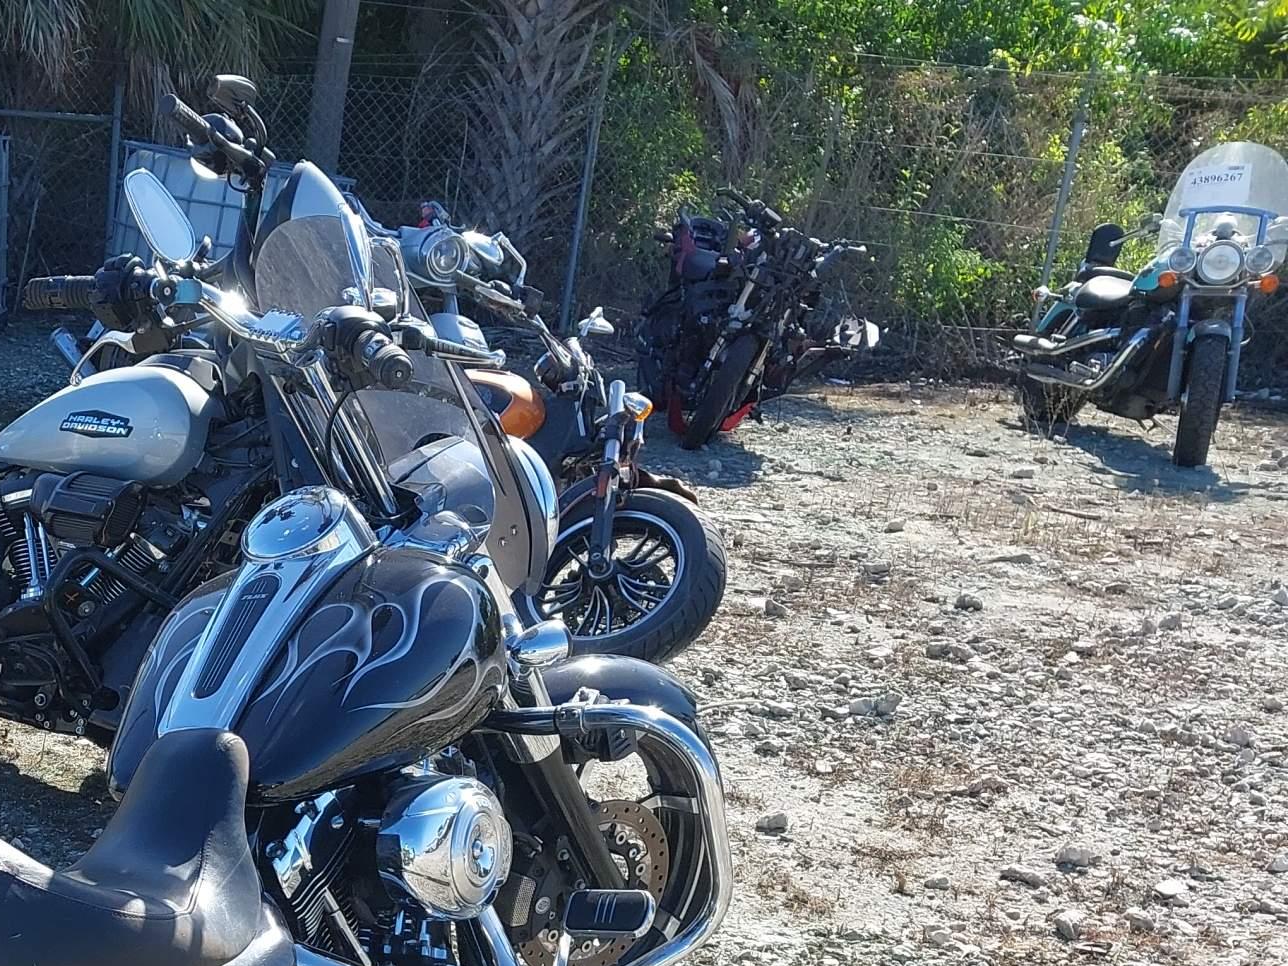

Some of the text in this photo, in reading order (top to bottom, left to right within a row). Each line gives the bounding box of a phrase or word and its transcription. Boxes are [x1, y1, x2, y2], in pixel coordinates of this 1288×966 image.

[1190, 172, 1244, 186] 43896267
[68, 415, 125, 426] HARLEY-
[61, 421, 129, 435] DAVIDSON
